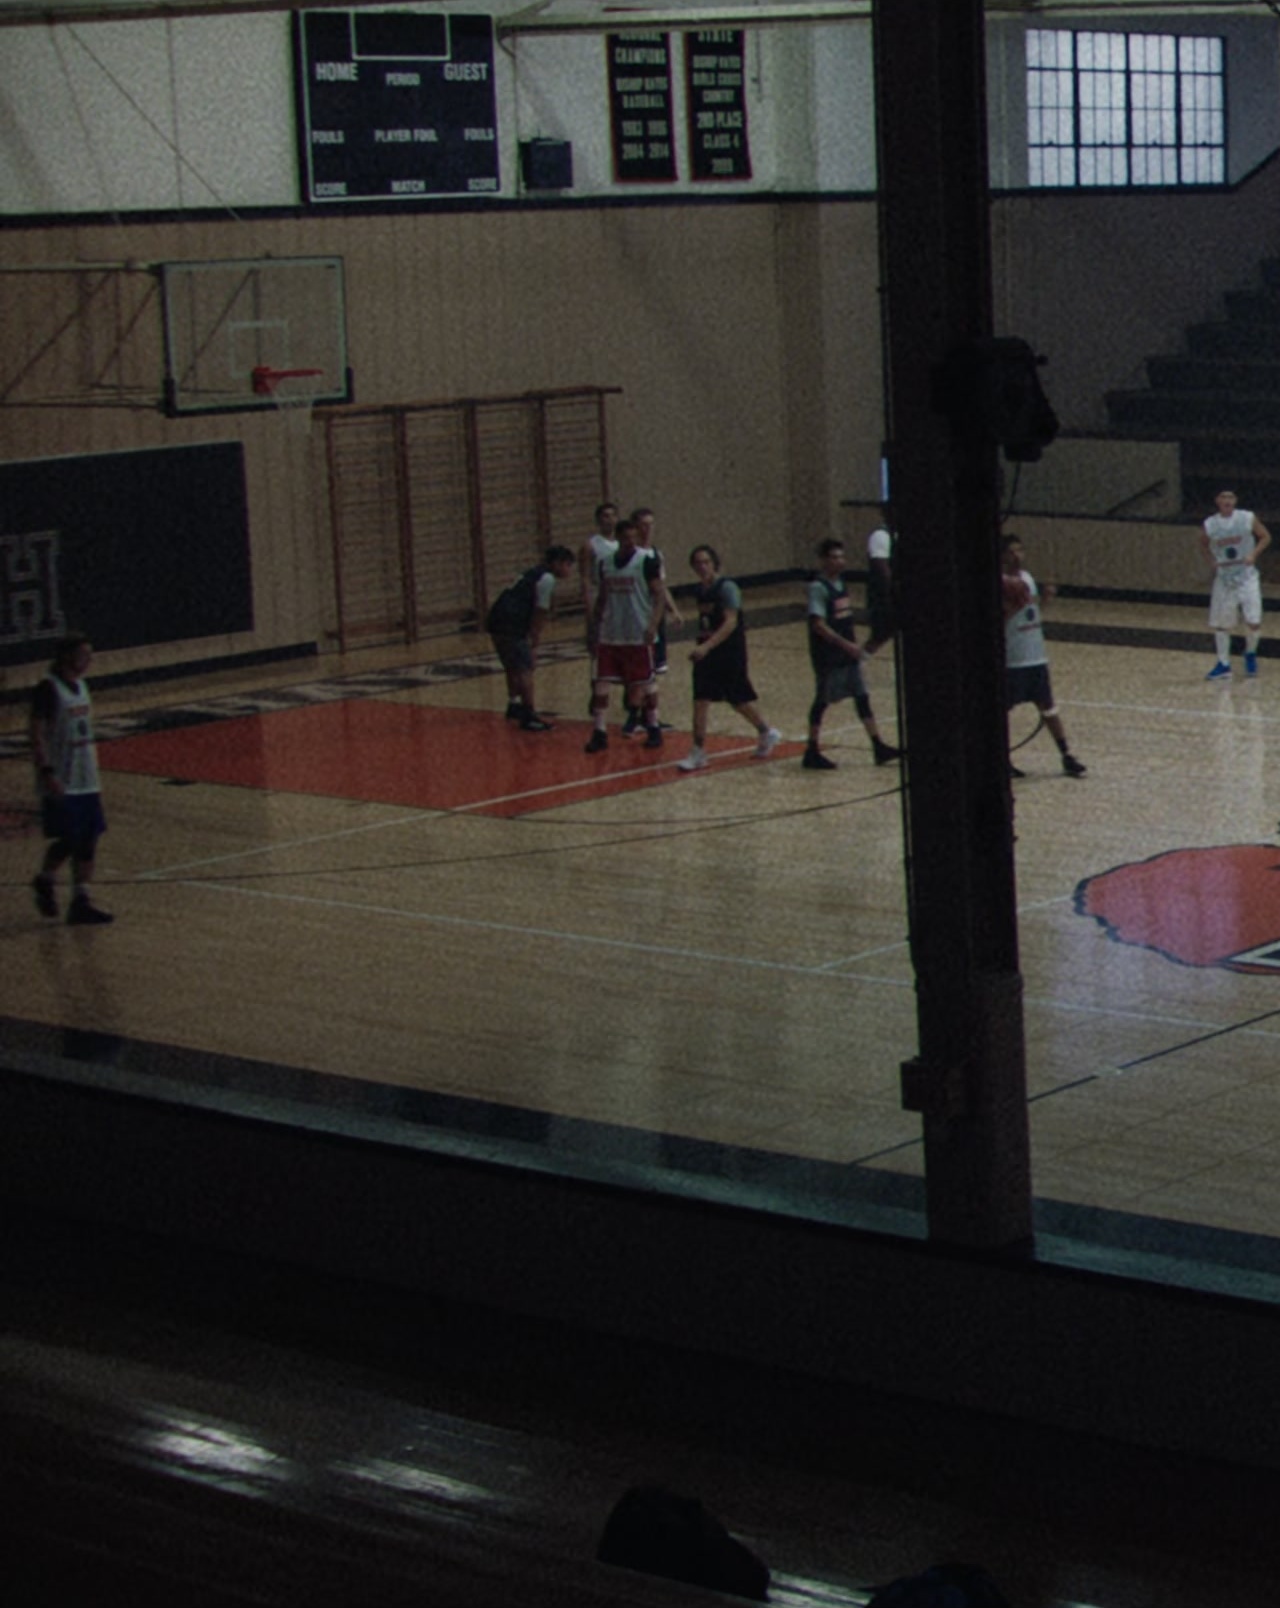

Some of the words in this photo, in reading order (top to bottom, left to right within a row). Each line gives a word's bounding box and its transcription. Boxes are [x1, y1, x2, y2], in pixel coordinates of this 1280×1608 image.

[315, 62, 359, 81] HOME
[443, 62, 488, 81] GUEST
[386, 72, 421, 86] PERIOD
[716, 111, 743, 128] PLACE
[312, 130, 345, 144] FOULS
[374, 129, 411, 142] PLAYER
[413, 129, 438, 142] FOUL
[463, 128, 495, 141] FOULS
[315, 182, 347, 196] SCORE
[391, 180, 426, 193] MATCH
[467, 178, 497, 191] SCORE
